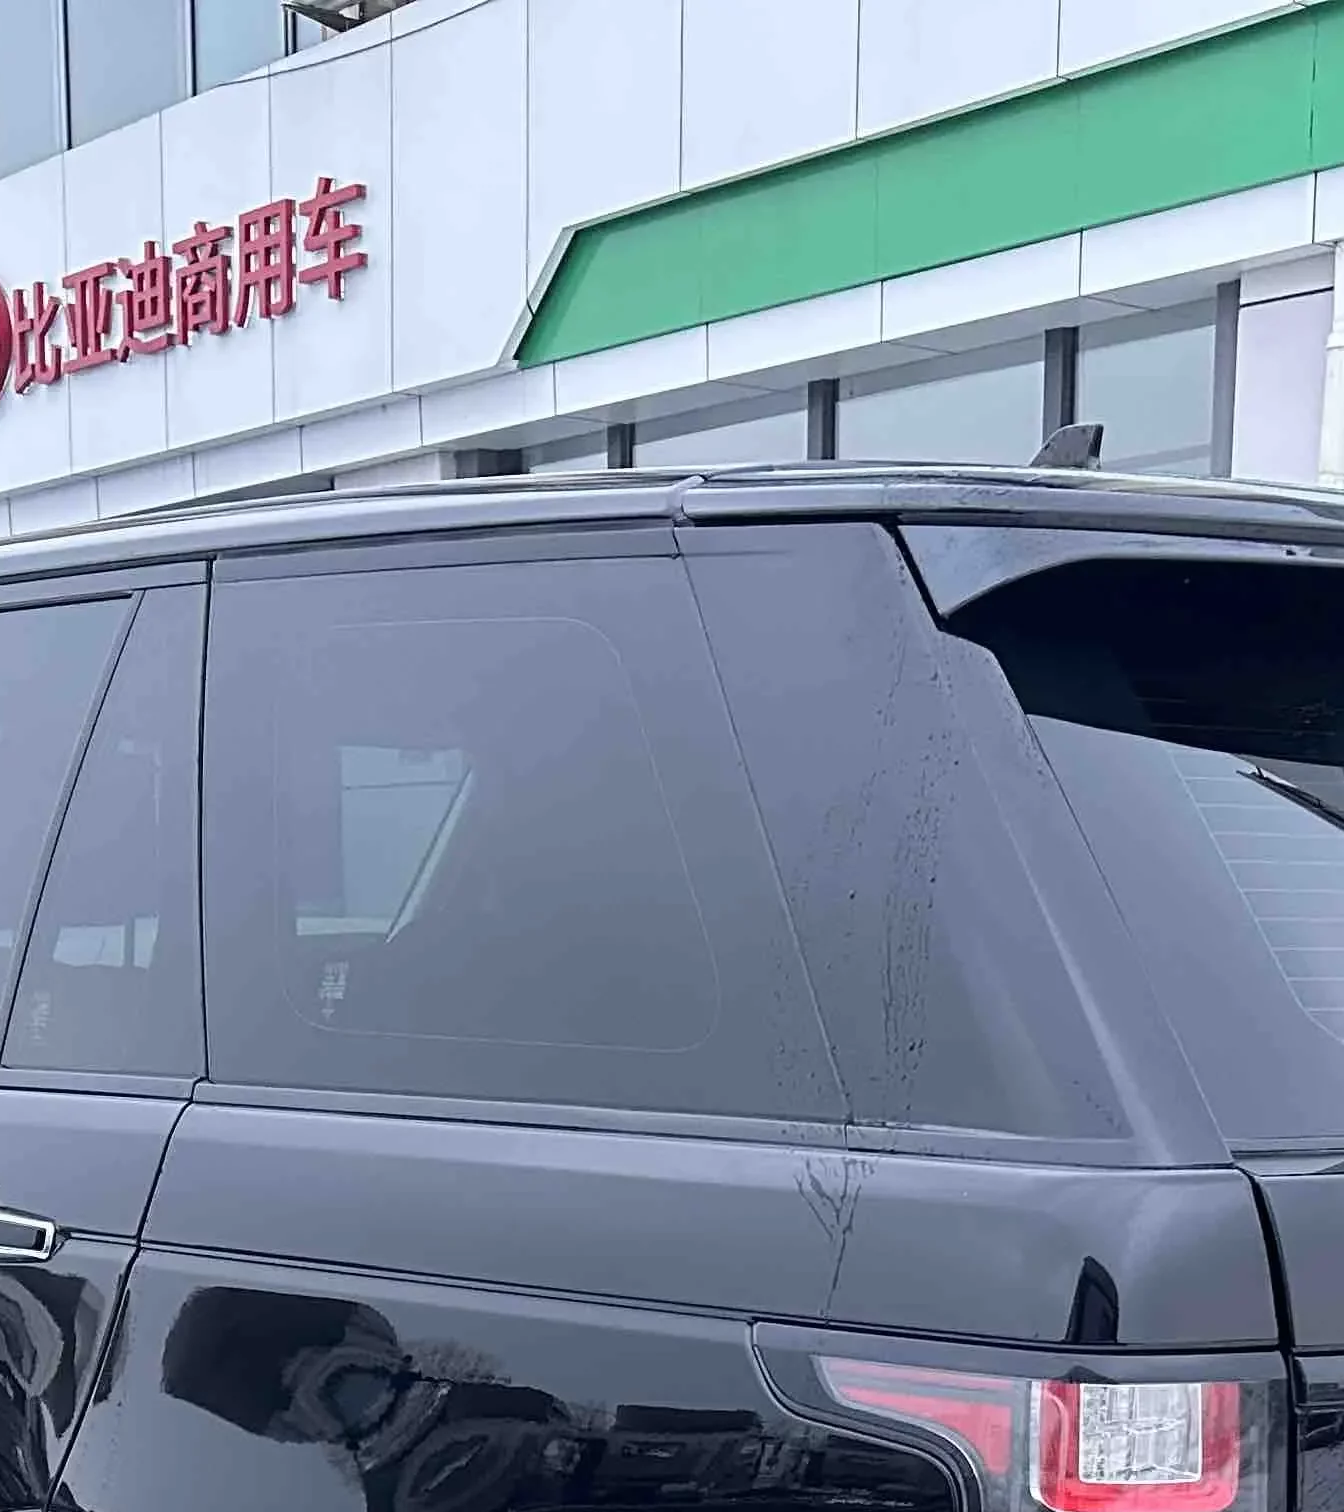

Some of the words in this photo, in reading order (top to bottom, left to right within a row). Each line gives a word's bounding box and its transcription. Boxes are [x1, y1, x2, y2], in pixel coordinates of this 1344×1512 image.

[11, 176, 368, 394] 比亚迪商用车
